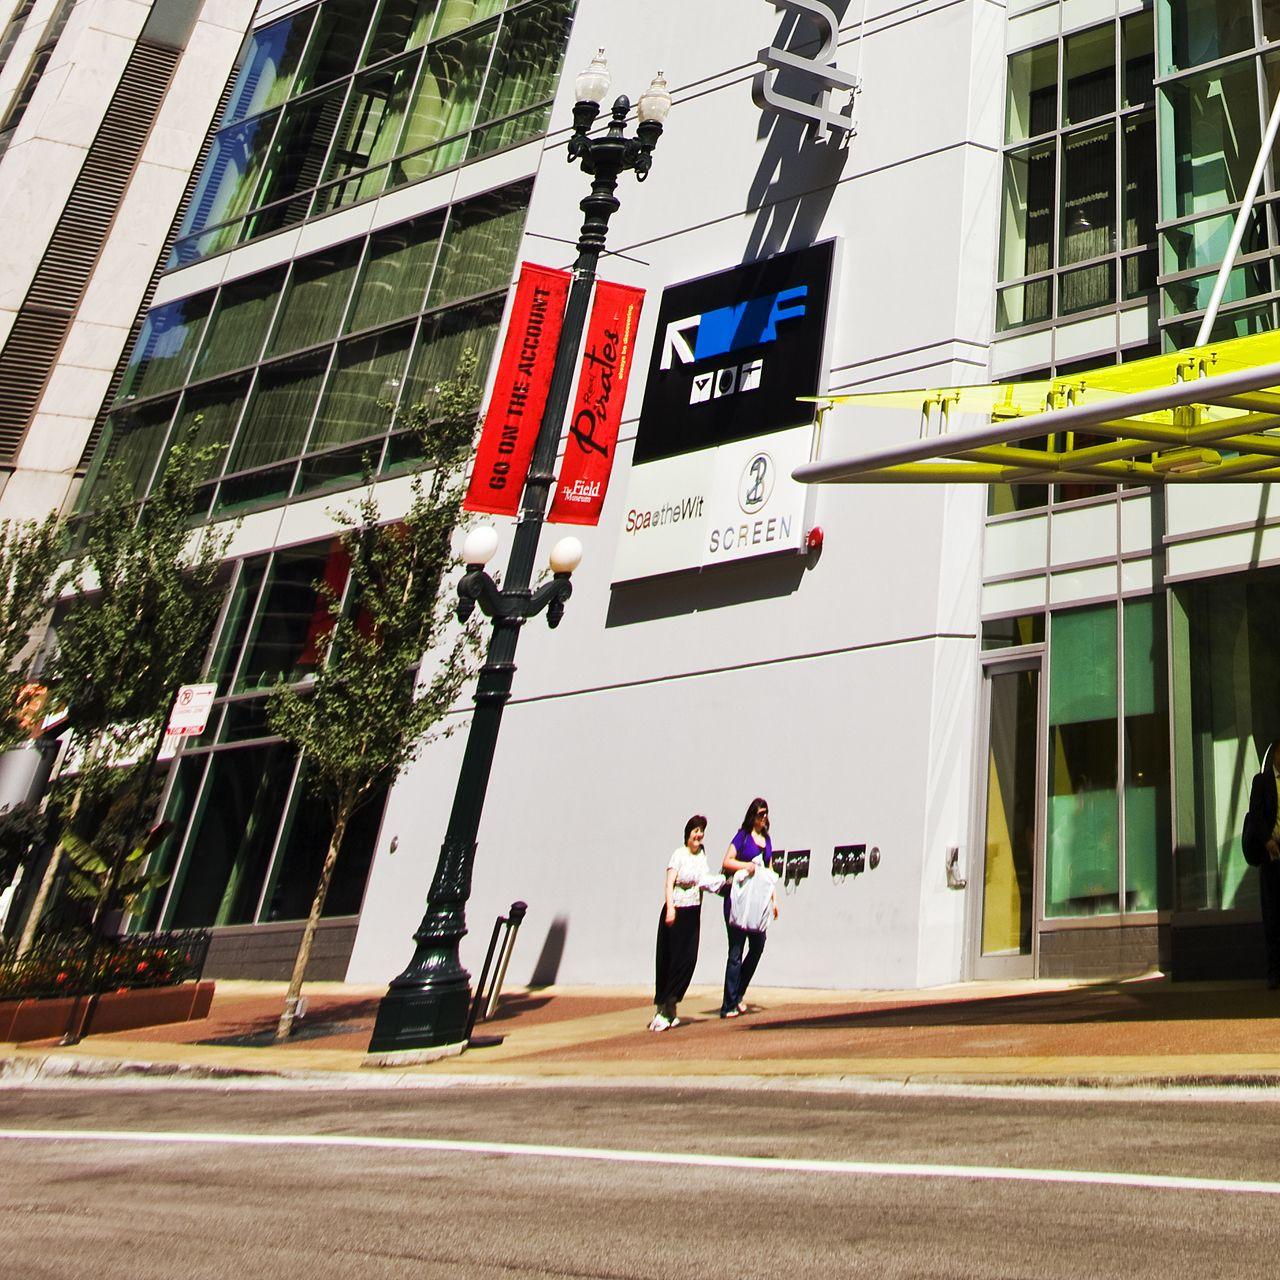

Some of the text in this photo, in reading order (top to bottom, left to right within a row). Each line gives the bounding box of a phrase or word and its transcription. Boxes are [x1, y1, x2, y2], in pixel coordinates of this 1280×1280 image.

[488, 286, 551, 490] GO ON THE ACCOUNT
[570, 328, 619, 459] Pirates
[564, 491, 592, 504] Museum
[573, 479, 601, 497] Field
[708, 515, 793, 553] SCREEN
